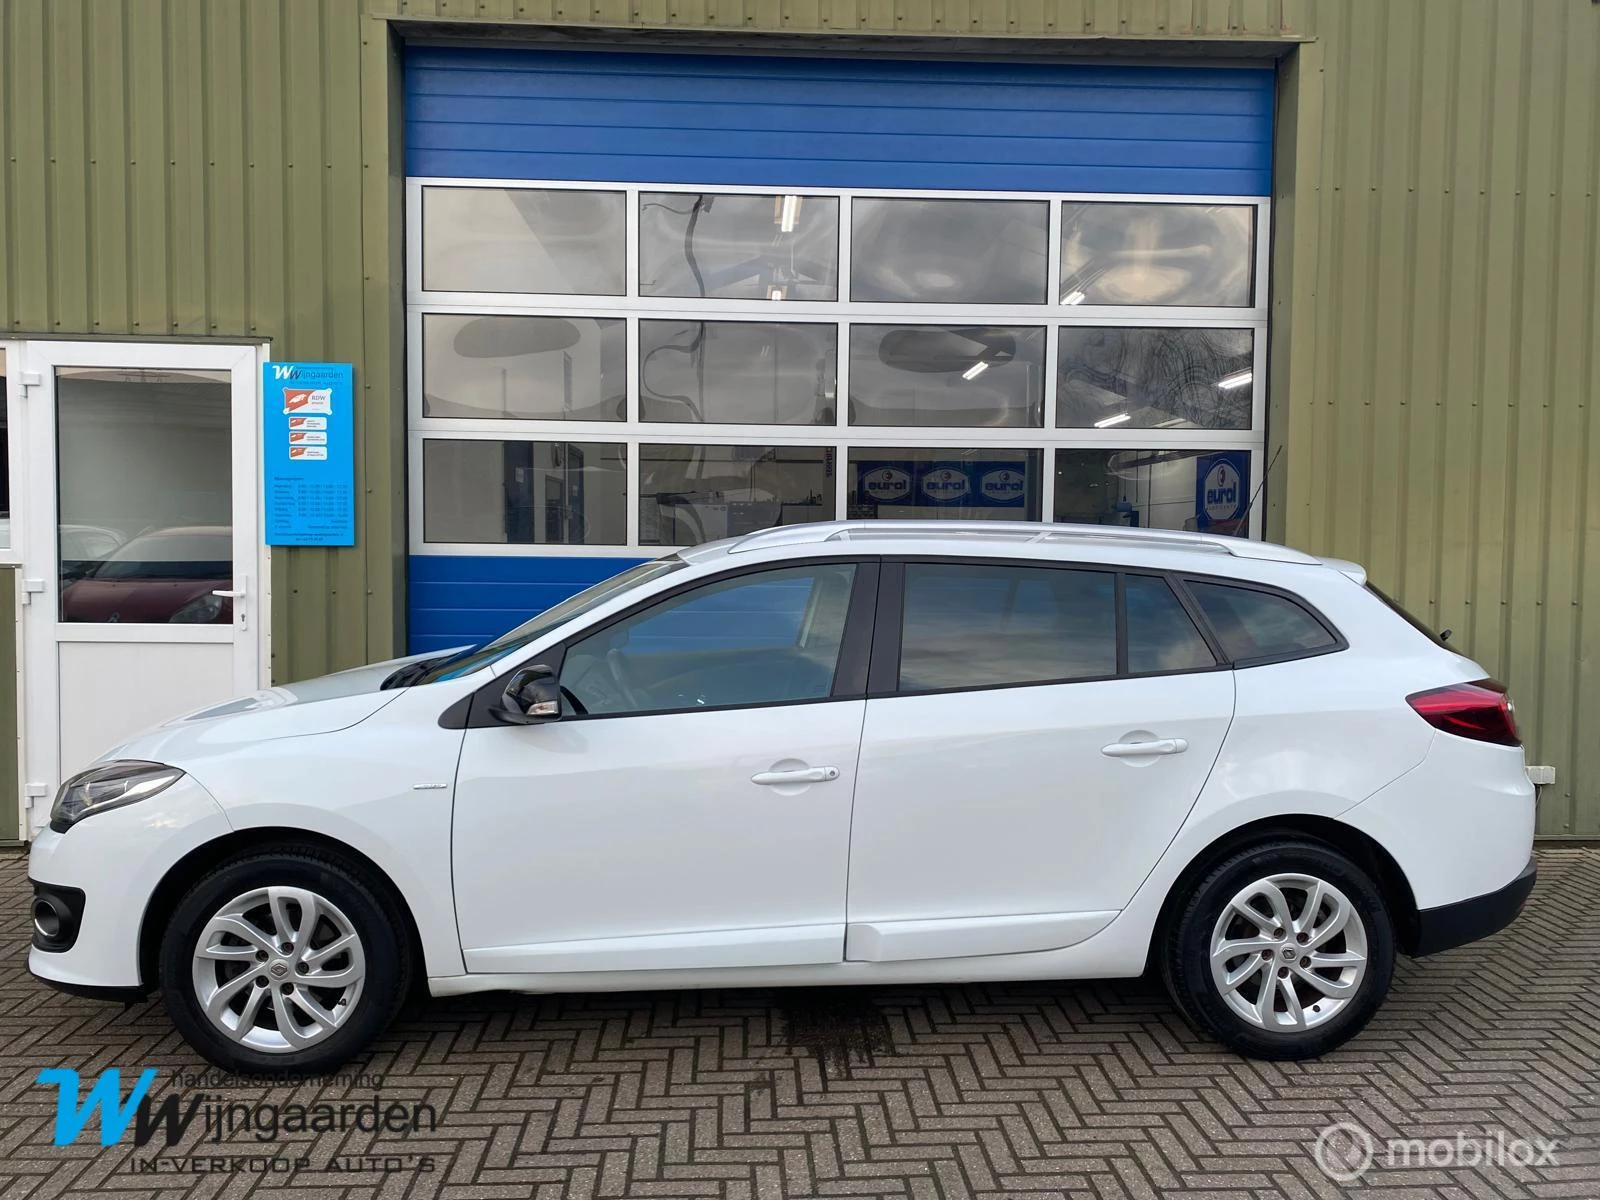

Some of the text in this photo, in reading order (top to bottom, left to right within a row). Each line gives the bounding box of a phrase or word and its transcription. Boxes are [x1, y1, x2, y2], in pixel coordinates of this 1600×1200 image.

[868, 479, 907, 490] eurol
[926, 479, 965, 490] eurol
[985, 480, 1024, 491] eurol
[1207, 481, 1237, 505] eurol
